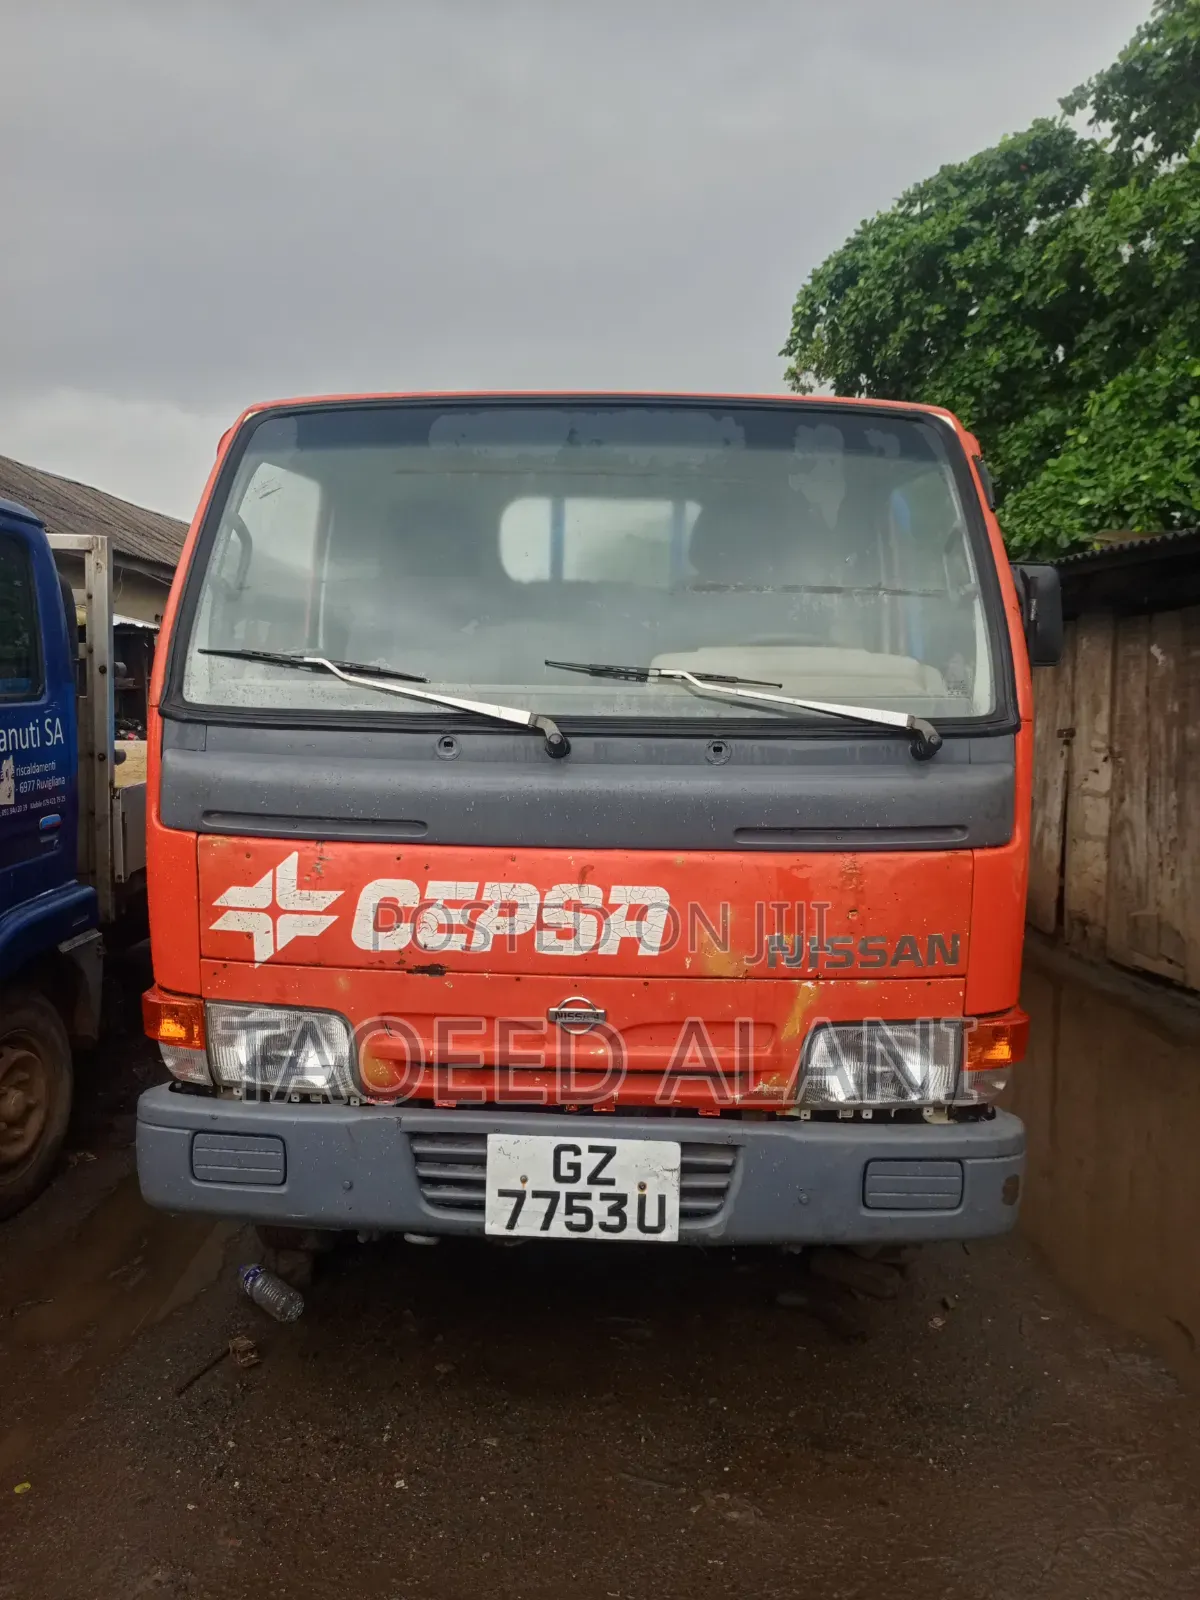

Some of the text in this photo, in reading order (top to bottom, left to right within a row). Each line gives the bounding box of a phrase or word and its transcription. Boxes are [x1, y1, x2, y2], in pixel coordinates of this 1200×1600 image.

[0, 717, 64, 752] anuti SA
[16, 760, 56, 776] riscaldamenti
[19, 780, 35, 793] 6977
[36, 776, 66, 790] Ruvigliana
[351, 878, 671, 956] CEPSA
[766, 933, 961, 969] NISSAN
[552, 1143, 617, 1187] GZ
[497, 1188, 667, 1234] 7753U
